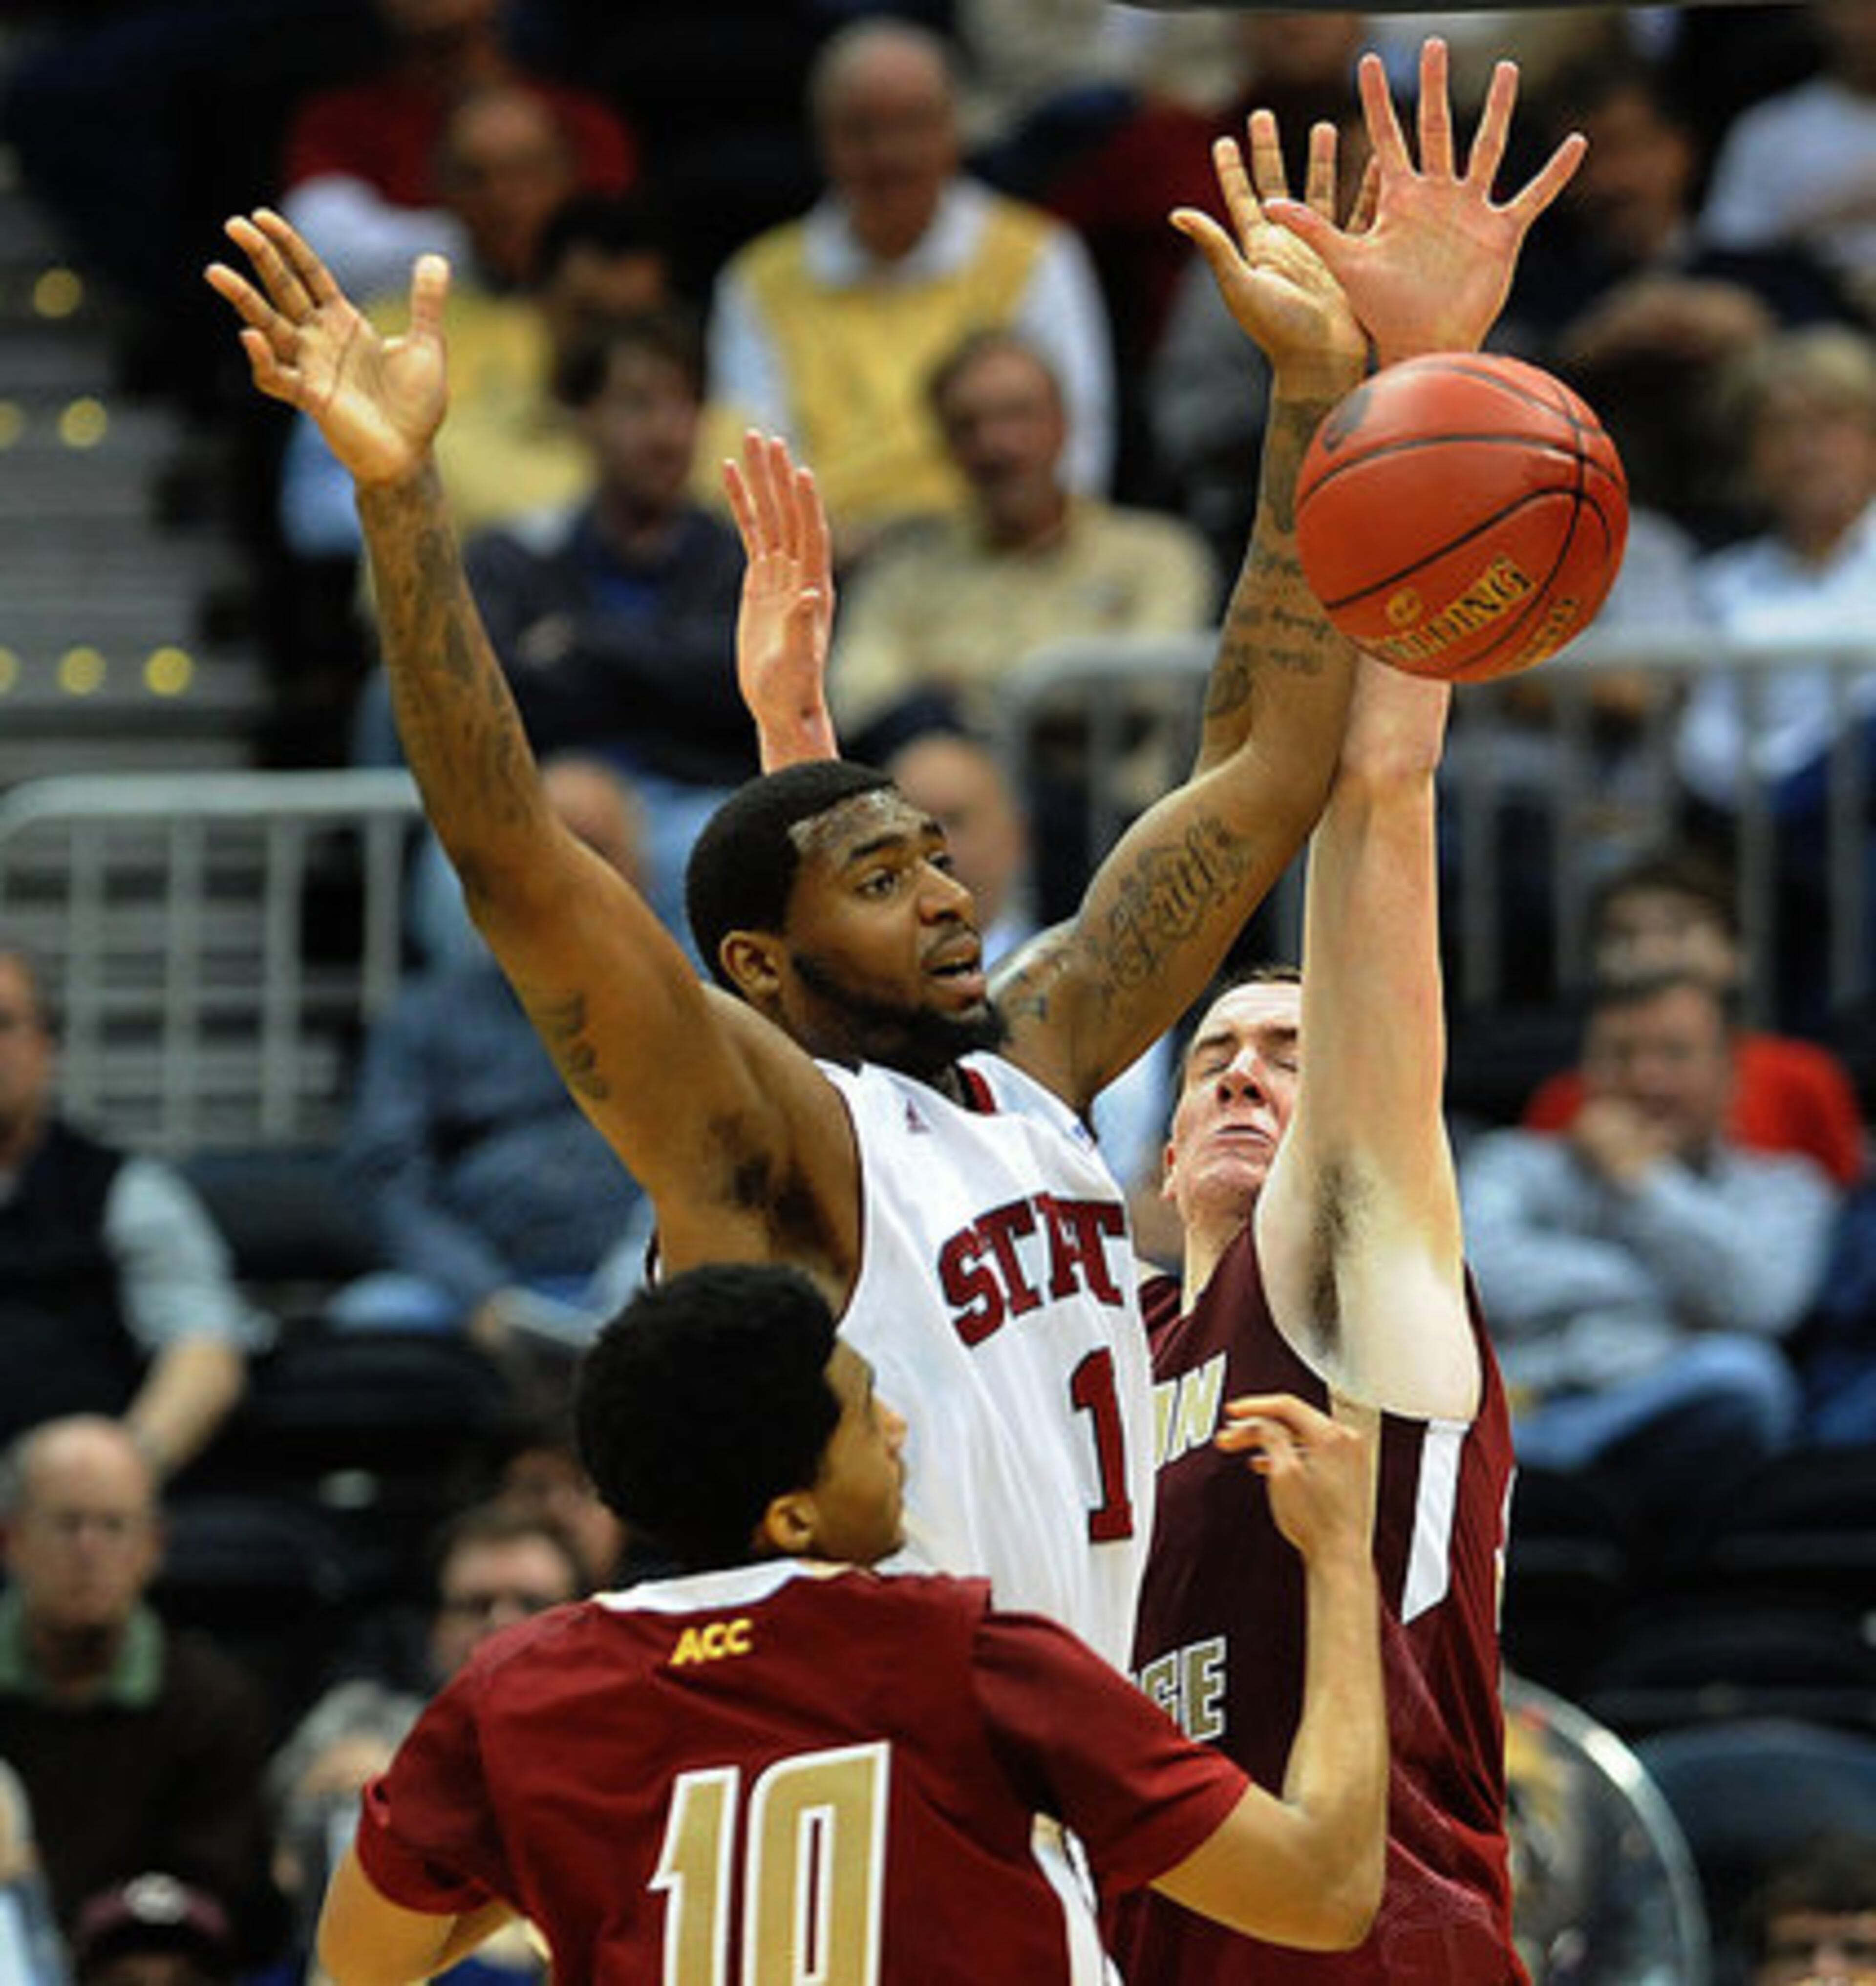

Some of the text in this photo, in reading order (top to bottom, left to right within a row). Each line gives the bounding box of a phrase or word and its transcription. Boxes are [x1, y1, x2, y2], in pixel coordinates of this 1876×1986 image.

[1070, 1345, 1133, 1544] 1
[670, 1619, 752, 1665] ACC
[1136, 1636, 1227, 1743] GE
[646, 1740, 891, 1986] 10
